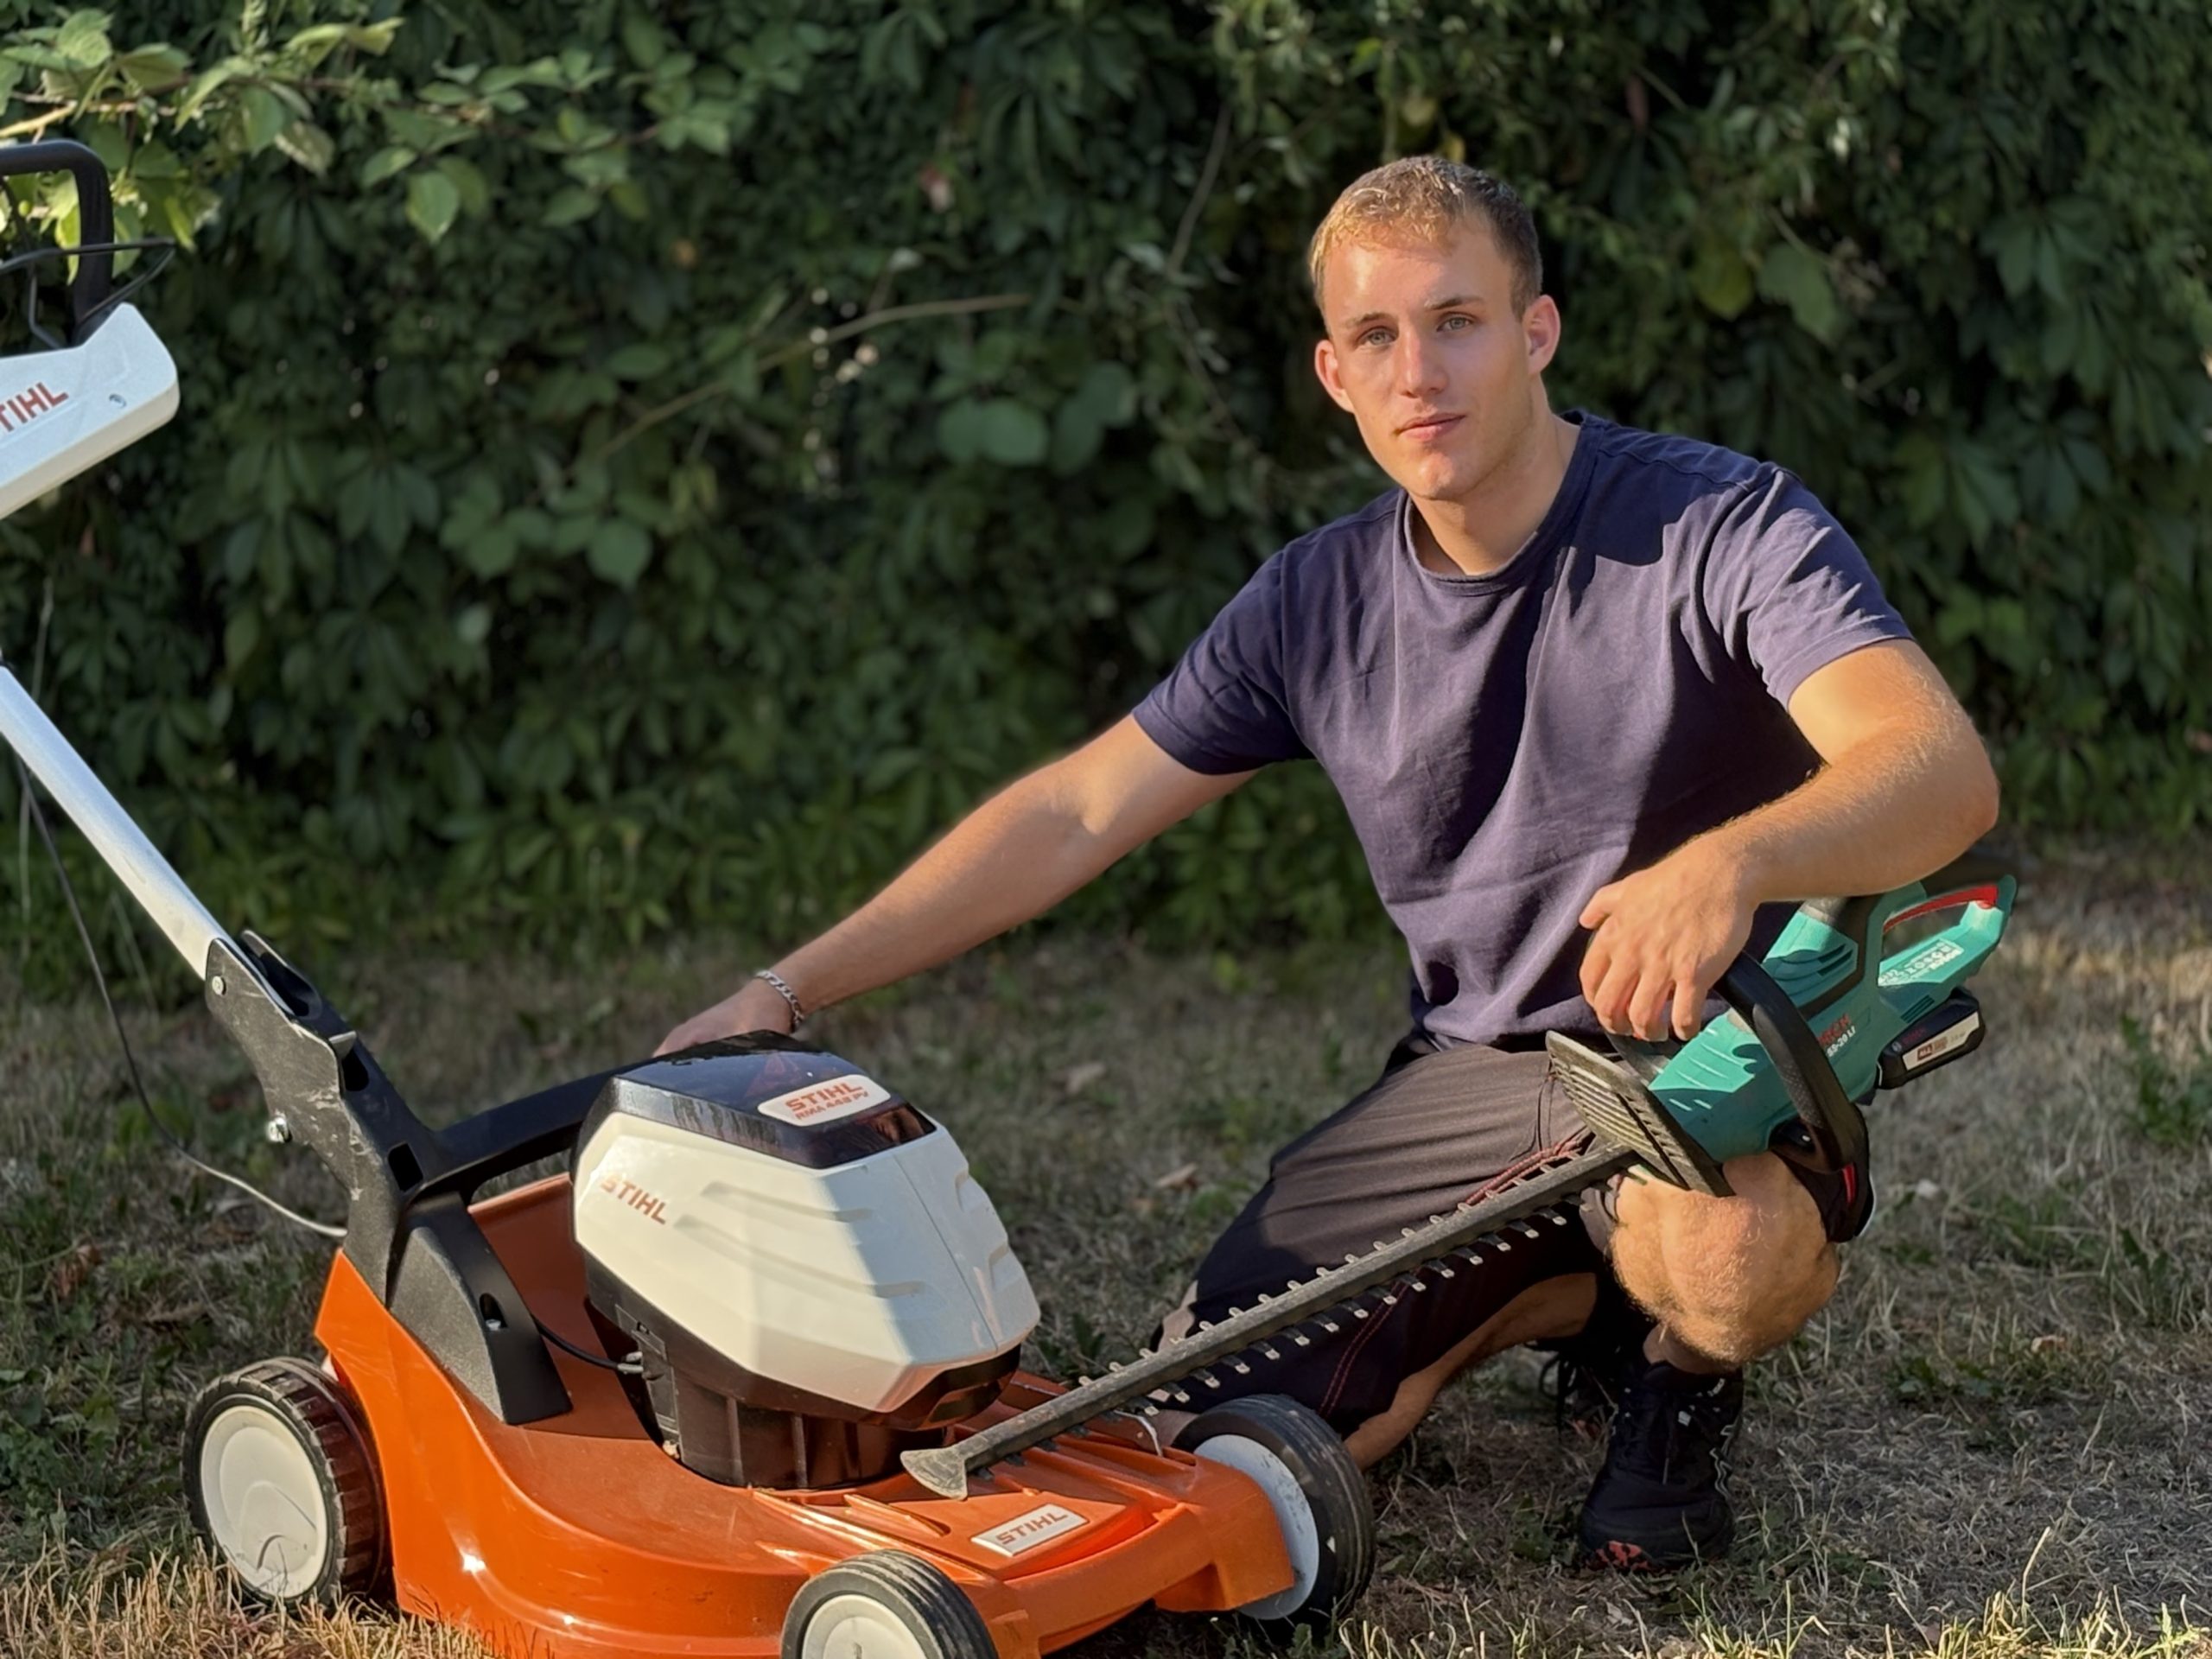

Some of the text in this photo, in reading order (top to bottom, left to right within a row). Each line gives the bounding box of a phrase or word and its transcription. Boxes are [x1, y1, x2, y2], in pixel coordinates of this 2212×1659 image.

[0, 382, 69, 432] TIHL
[785, 1083, 863, 1111] STIHL
[795, 1105, 826, 1120] RMA
[600, 1175, 666, 1225] STIHL
[995, 1513, 1069, 1545] STIHL
